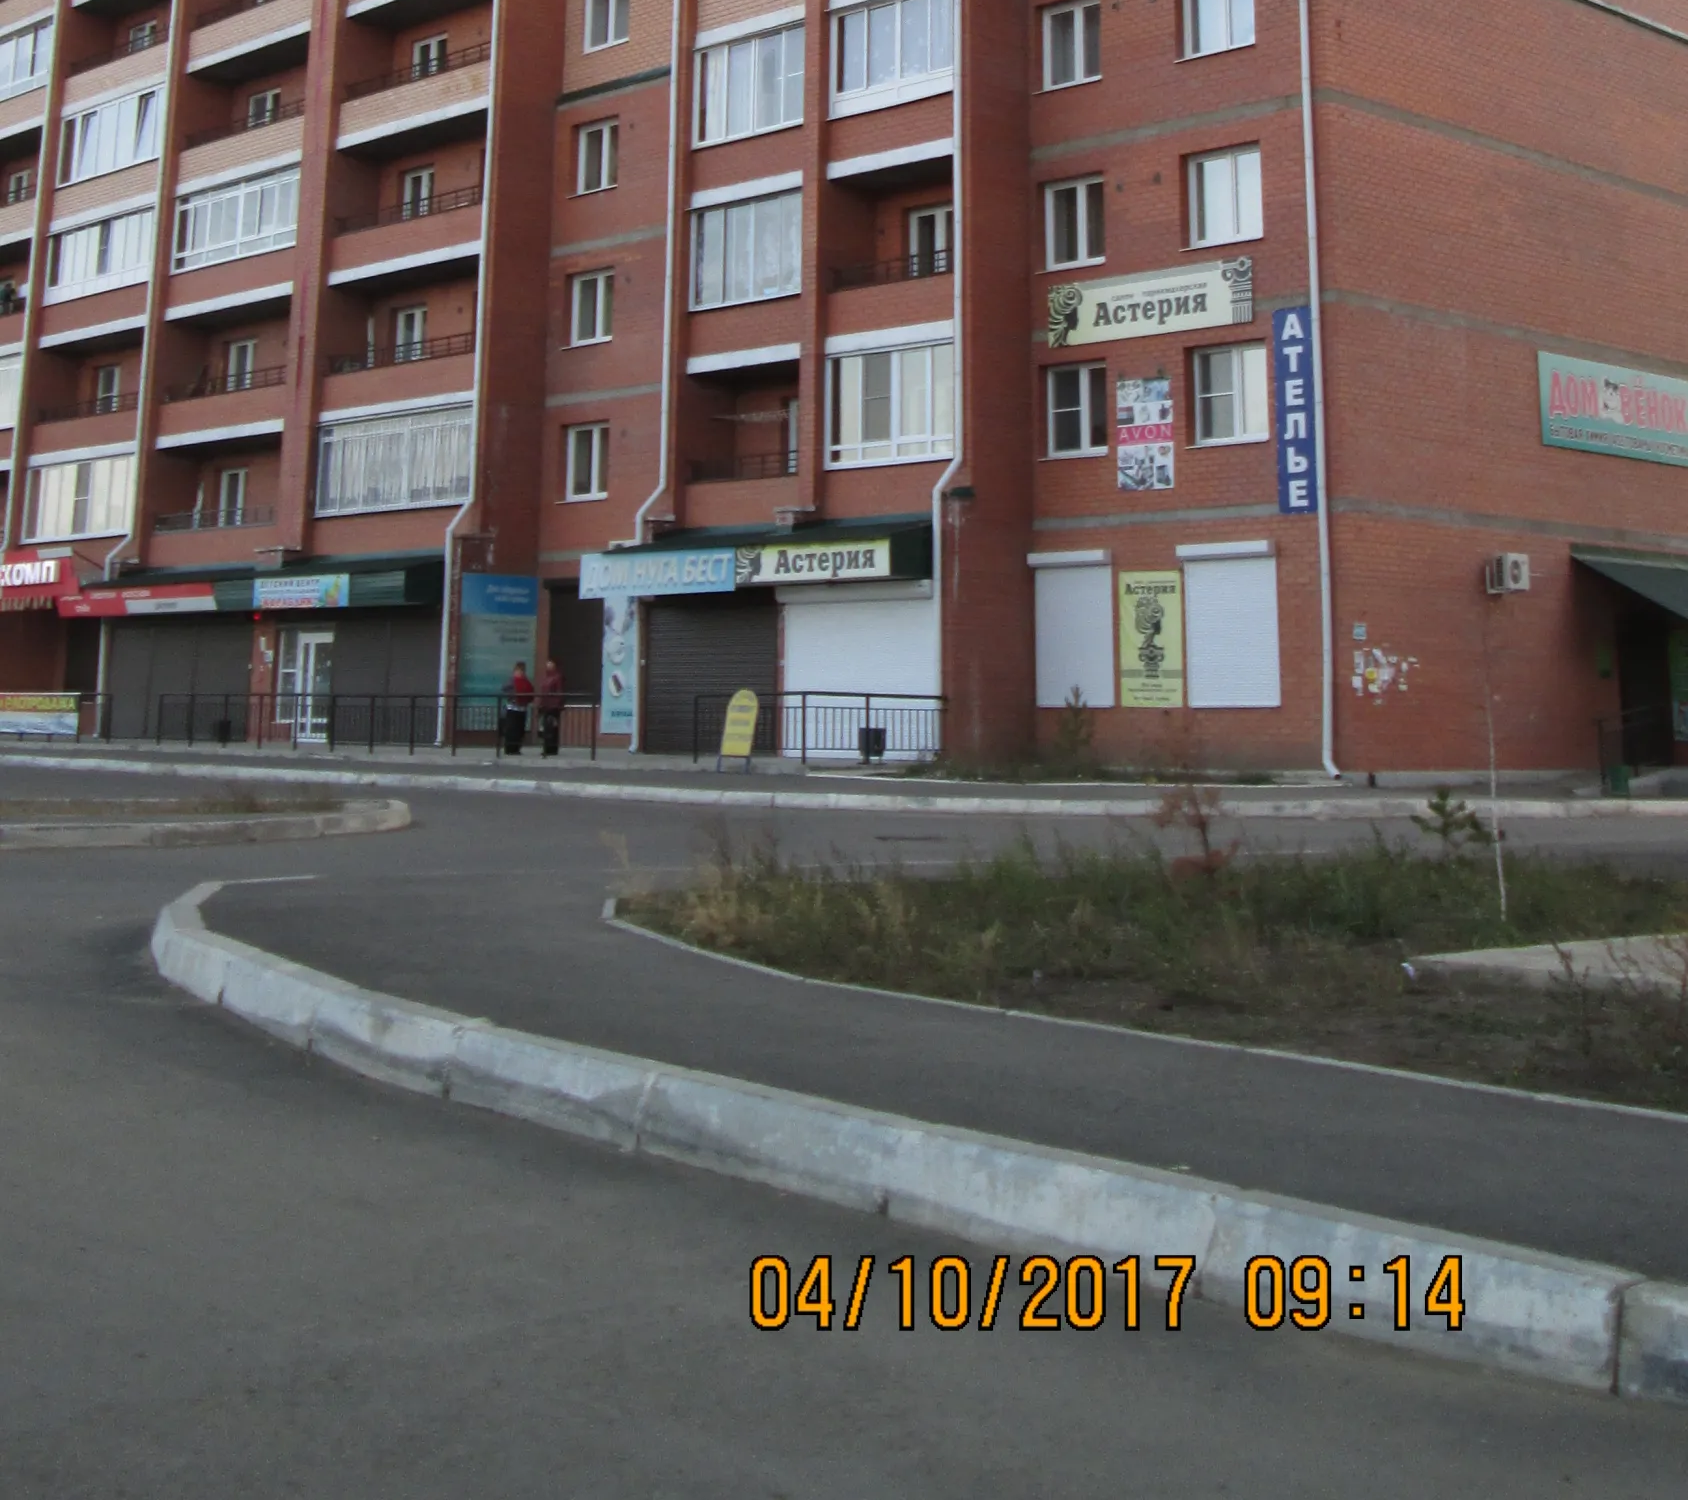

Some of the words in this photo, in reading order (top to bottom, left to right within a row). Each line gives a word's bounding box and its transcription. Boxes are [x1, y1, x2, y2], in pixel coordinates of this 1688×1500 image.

[1092, 293, 1208, 327] Астерия
[1281, 313, 1309, 508] АТЕЛЬЕ
[1120, 425, 1172, 441] AVON
[583, 560, 630, 594] ДОМ
[633, 556, 678, 587] НУГА
[683, 553, 733, 586] БЕСТ
[774, 549, 875, 577] Астерия
[1125, 583, 1176, 597] Астерия
